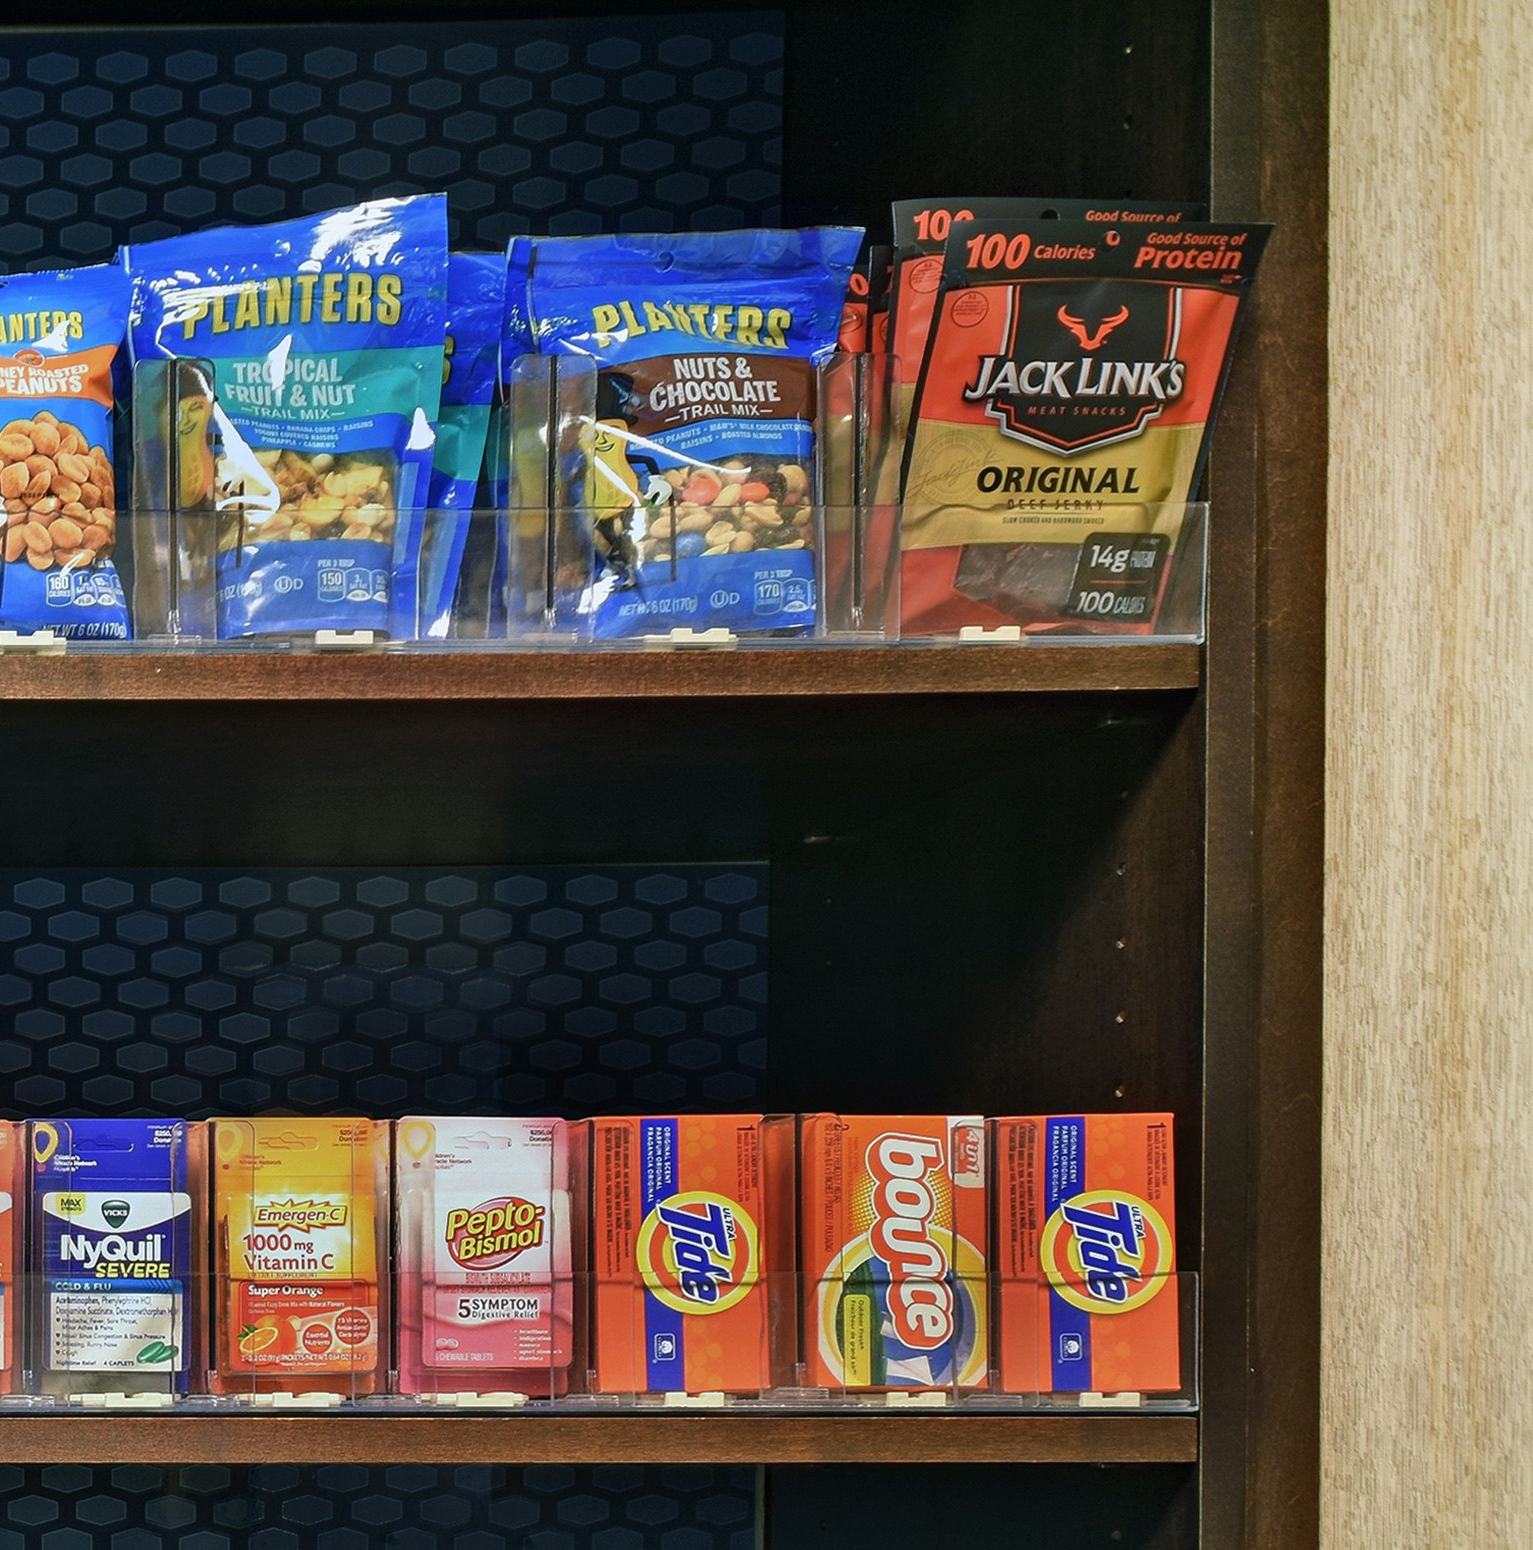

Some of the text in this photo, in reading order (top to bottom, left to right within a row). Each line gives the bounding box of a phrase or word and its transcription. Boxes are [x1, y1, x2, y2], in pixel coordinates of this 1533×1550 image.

[966, 234, 1096, 270] 100 Calories
[1147, 232, 1247, 246] Good Source of
[1134, 245, 1243, 270] Protein
[183, 273, 402, 339] PLANTERS
[592, 302, 792, 347] PLANTERS
[28, 364, 88, 377] ROASTED
[674, 358, 729, 379] NUTS
[965, 357, 1185, 401] JACK LINK'S
[649, 381, 780, 413] CHOCOLATE
[1028, 406, 1126, 416] MEAT SNACKS
[977, 465, 1141, 494] ORIGINAL
[663, 1125, 671, 1160] ORIGINAL
[723, 1208, 735, 1239] ULTRA
[61, 1235, 161, 1265] NyQuil
[242, 1233, 292, 1251] 1000
[459, 1230, 541, 1261] Bismol
[657, 1203, 731, 1305] Tide
[880, 1140, 953, 1340] bounce
[1061, 1202, 1140, 1302] Tide
[95, 1262, 170, 1278] SEVERE
[245, 1253, 333, 1271] Vitamin C
[248, 1285, 323, 1297] Super Orange
[458, 1298, 538, 1318] 5 SYMPTOM
